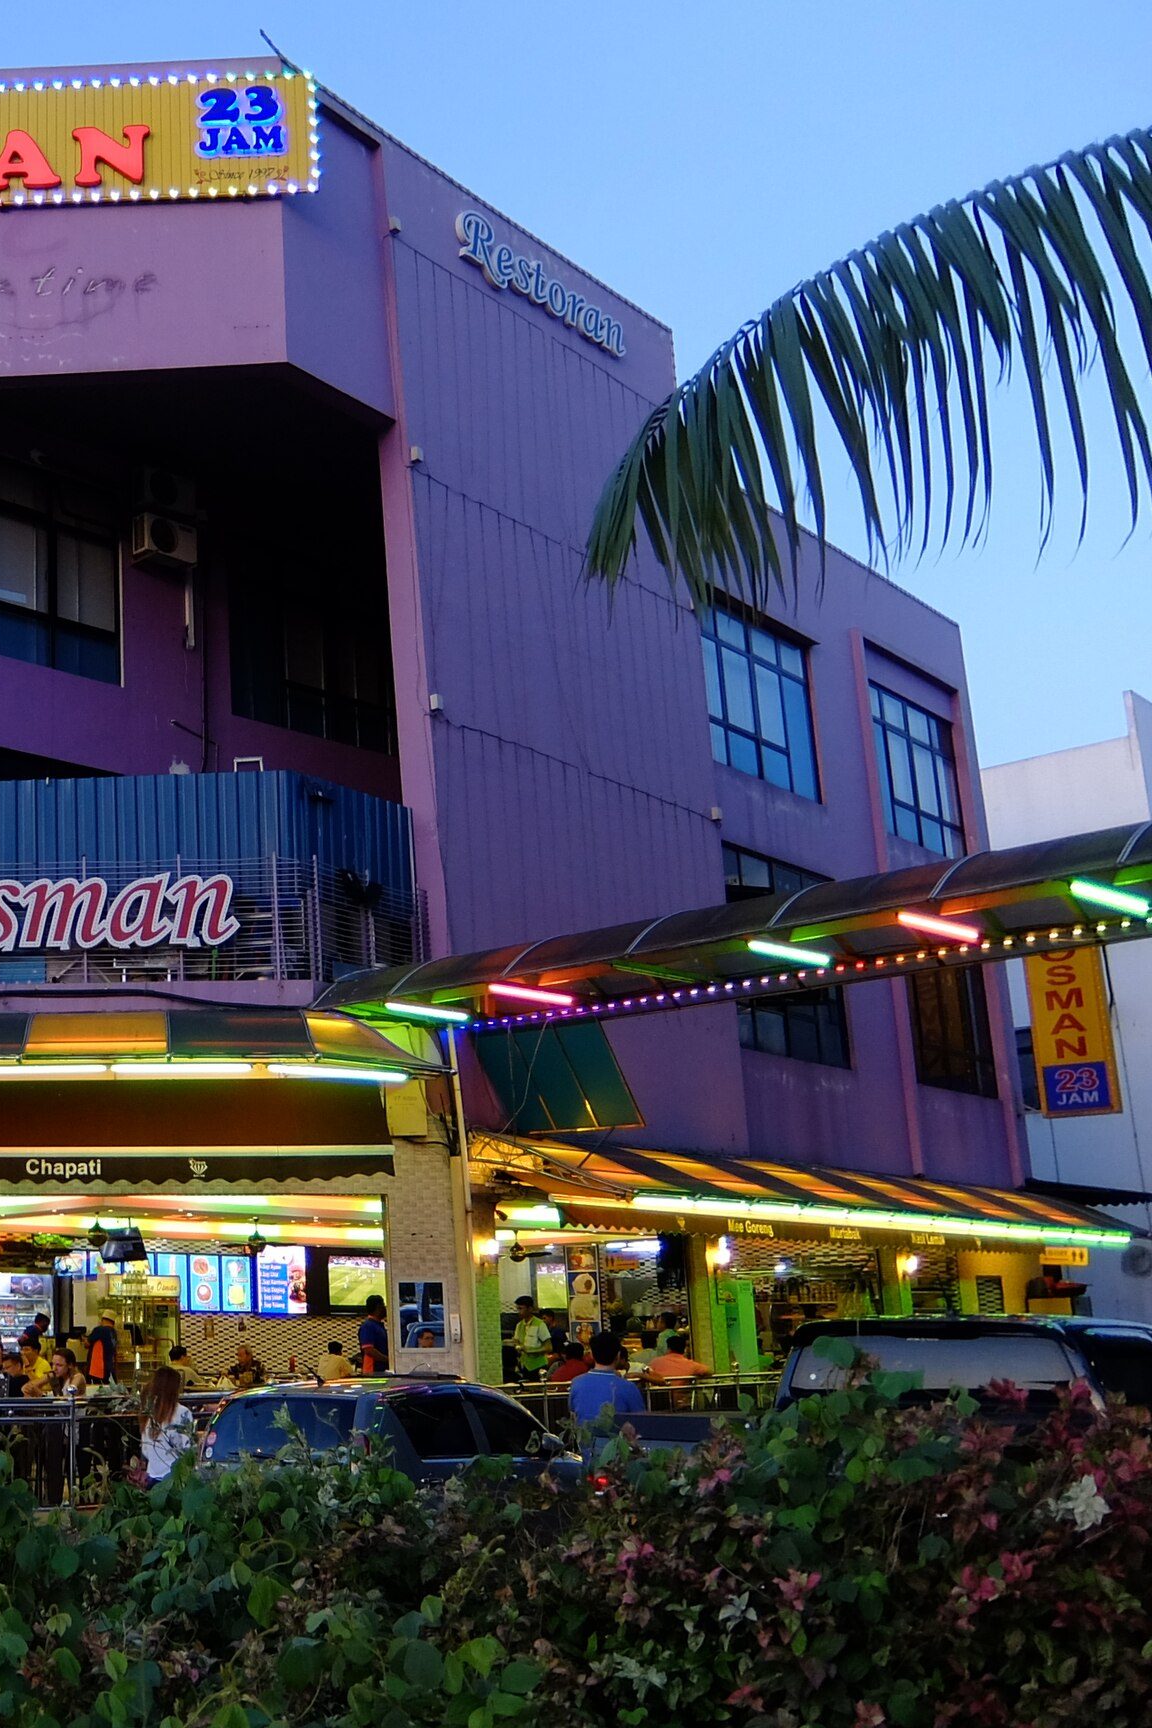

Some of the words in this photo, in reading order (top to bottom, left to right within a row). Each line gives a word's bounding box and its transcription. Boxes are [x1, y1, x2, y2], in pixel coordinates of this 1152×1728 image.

[199, 85, 279, 122] 23
[198, 126, 284, 152] JAM
[455, 210, 626, 357] Restoran
[1054, 1067, 1100, 1093] 23
[1057, 1091, 1099, 1106] JAM
[24, 1157, 103, 1179] Chapati
[727, 1218, 744, 1233] Mee
[745, 1219, 774, 1238] Goreng
